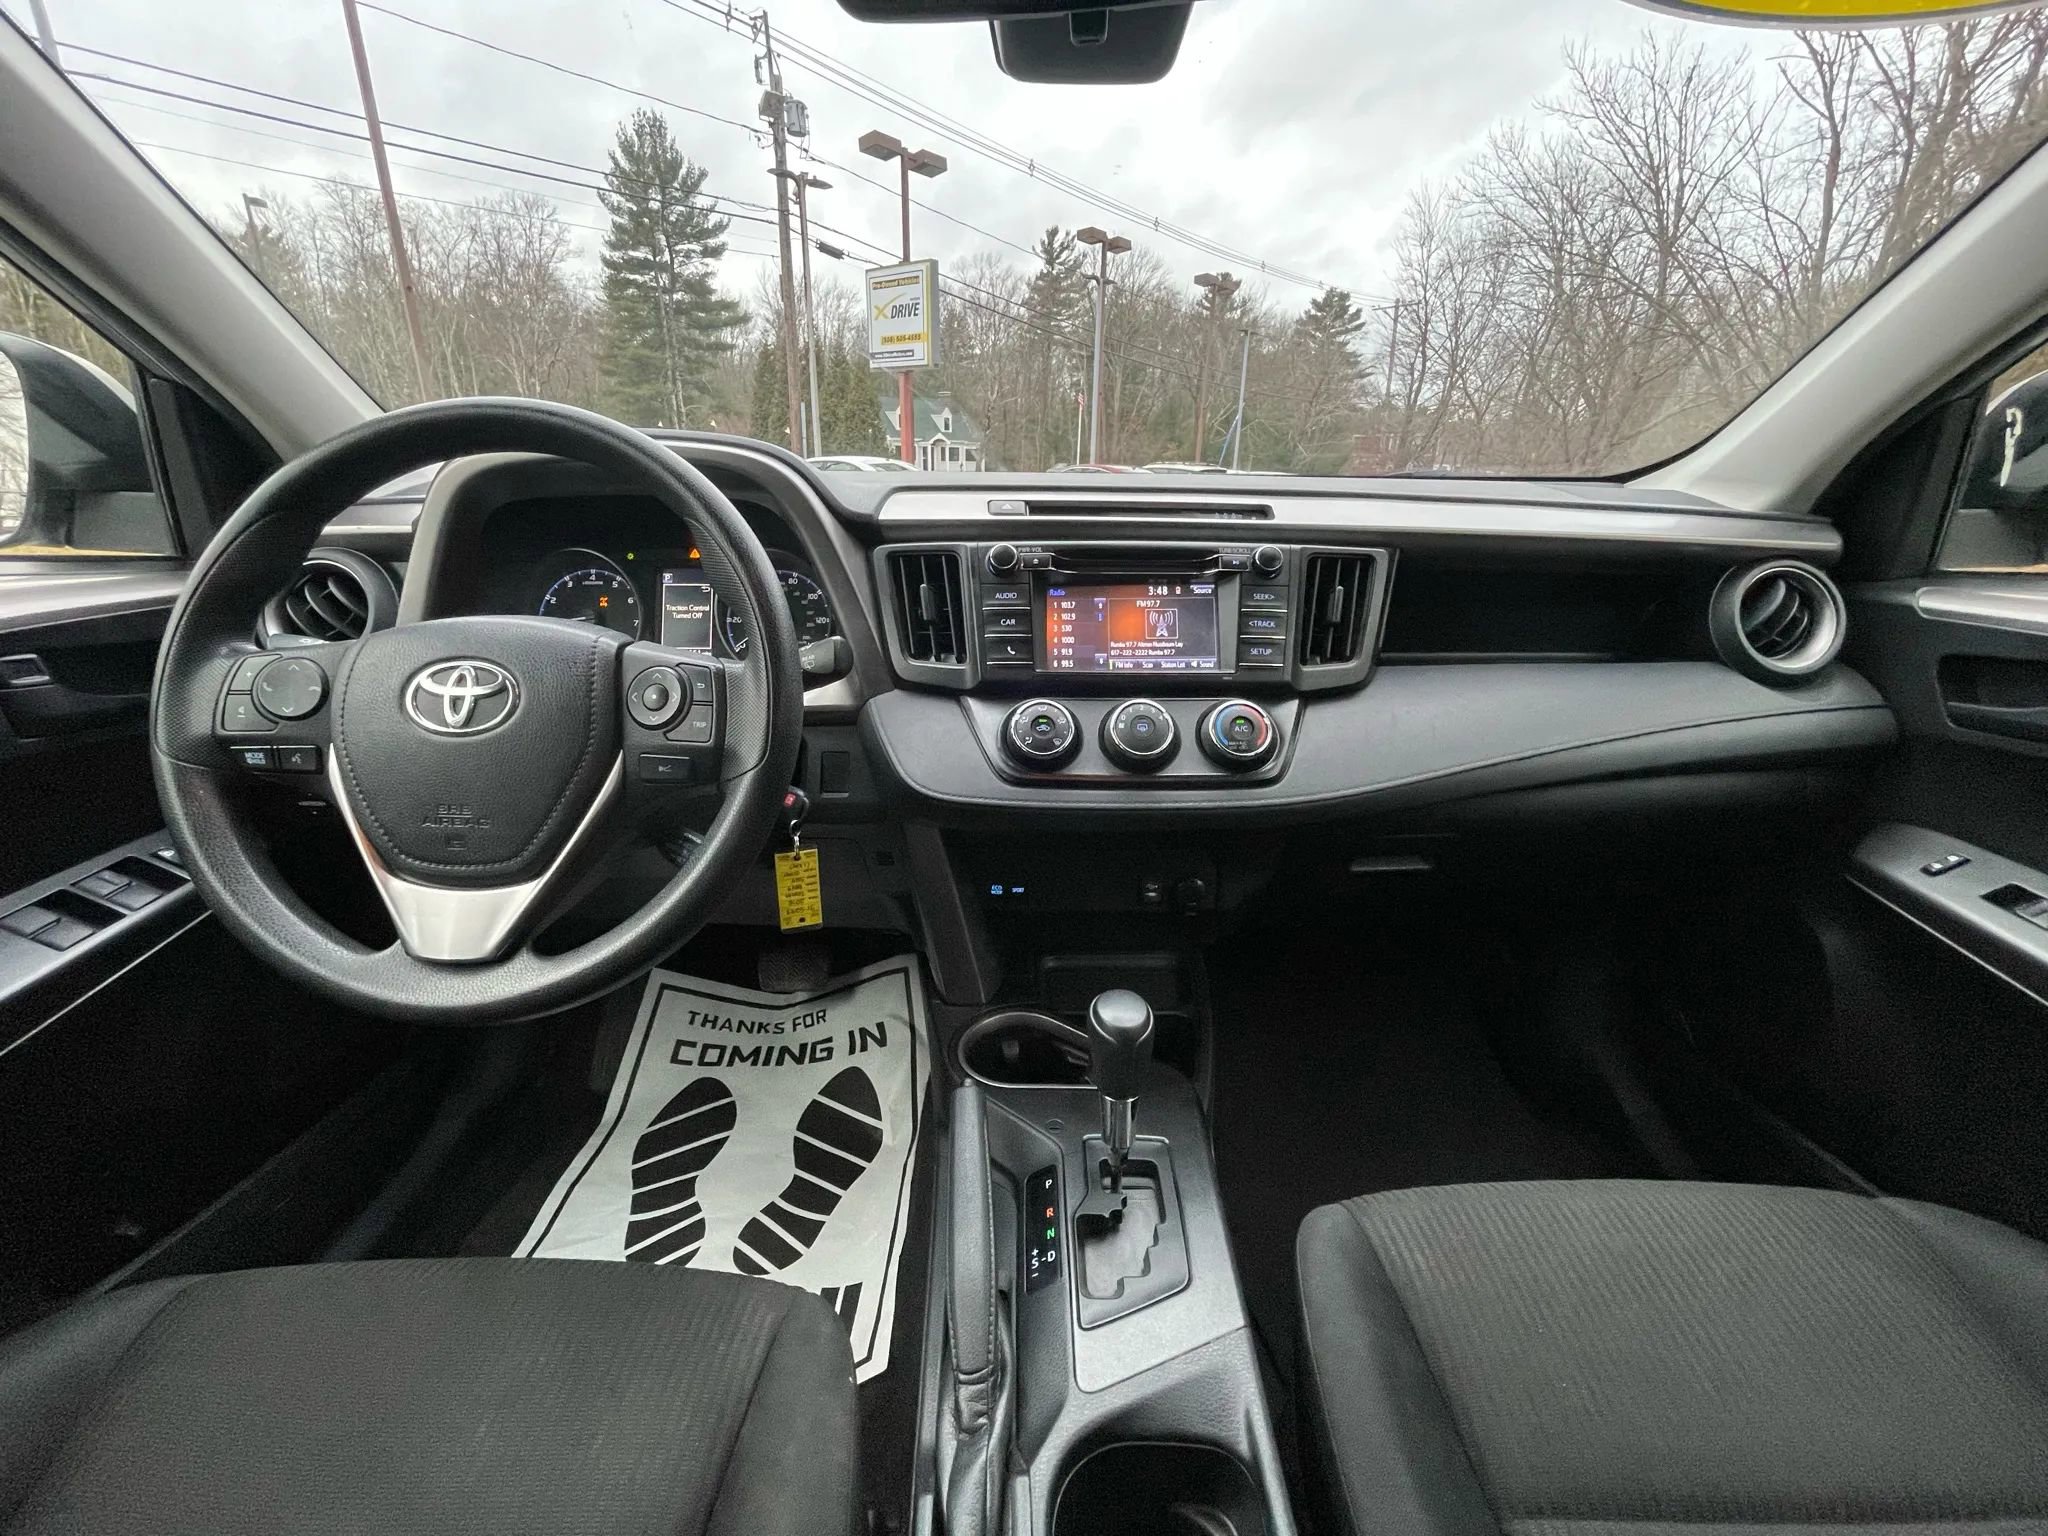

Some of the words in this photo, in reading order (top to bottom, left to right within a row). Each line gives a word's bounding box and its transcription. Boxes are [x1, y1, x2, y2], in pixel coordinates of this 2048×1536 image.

[890, 302, 920, 319] DRIVE
[1148, 586, 1168, 596] 3:48
[633, 619, 640, 627] 7
[687, 1010, 786, 1034] THANKS
[792, 1008, 827, 1032] FOR
[670, 1036, 835, 1068] COMING
[848, 1021, 888, 1056] IN
[1045, 1179, 1053, 1189] P
[1046, 1207, 1054, 1218] R
[1046, 1227, 1055, 1240] N
[1047, 1250, 1056, 1262] D
[1031, 1258, 1039, 1270] S
